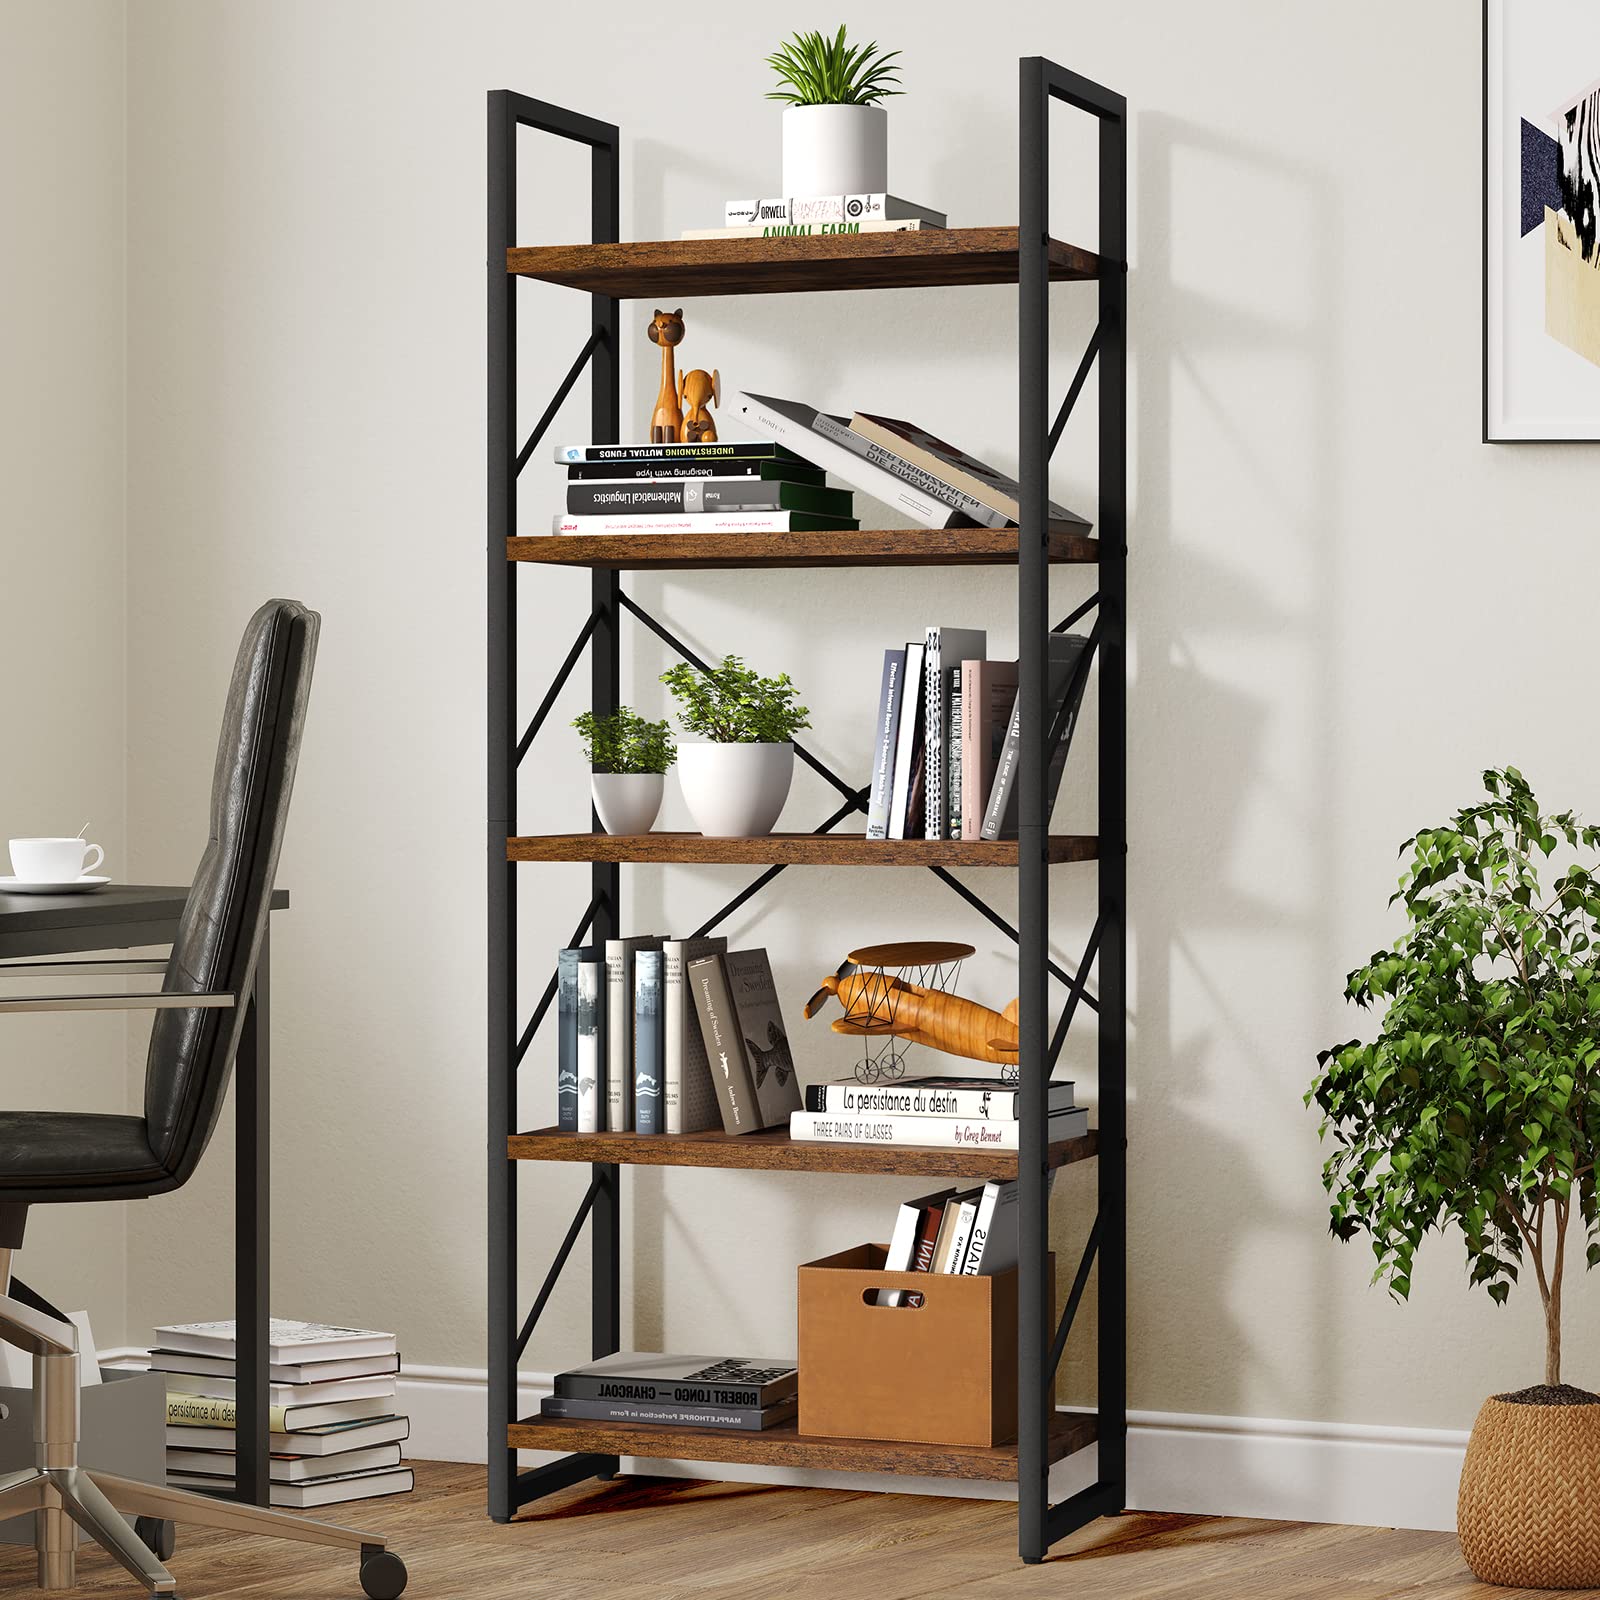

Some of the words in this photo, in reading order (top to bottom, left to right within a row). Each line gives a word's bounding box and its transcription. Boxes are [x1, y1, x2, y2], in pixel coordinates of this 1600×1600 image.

[760, 205, 786, 219] ORWELL
[599, 449, 627, 458] FUNDS
[628, 448, 663, 457] MUTUAL
[665, 446, 734, 457] UNDERSTANDING
[635, 467, 654, 479] Type
[655, 468, 673, 478] with
[675, 468, 713, 479] Designing
[593, 492, 631, 506] Linguistics
[632, 491, 681, 505] Mathematical
[889, 662, 897, 689] Effective
[887, 689, 895, 713] Internet
[885, 713, 893, 734] Search
[952, 697, 962, 737] MATHEMATICAL
[1002, 761, 1010, 777] LOGIC
[1000, 777, 1006, 785] OF
[701, 978, 714, 1012] Dreaming
[709, 1010, 715, 1018] of
[711, 1017, 722, 1047] Sweden
[728, 1086, 737, 1106] Andrew
[843, 1086, 854, 1109] La
[857, 1087, 911, 1114] persistance
[913, 1089, 926, 1112] du
[928, 1091, 958, 1114] destin
[732, 1106, 740, 1125] Brown
[813, 1121, 833, 1138] THREE
[834, 1122, 853, 1139] PAIRS
[854, 1123, 863, 1139] OF
[865, 1124, 893, 1140] GLASSES
[954, 1125, 963, 1143] by
[963, 1125, 979, 1144] Greg
[980, 1126, 1002, 1143] Bennet
[168, 1400, 208, 1423] persistance
[210, 1402, 220, 1421] du
[221, 1403, 234, 1422] des
